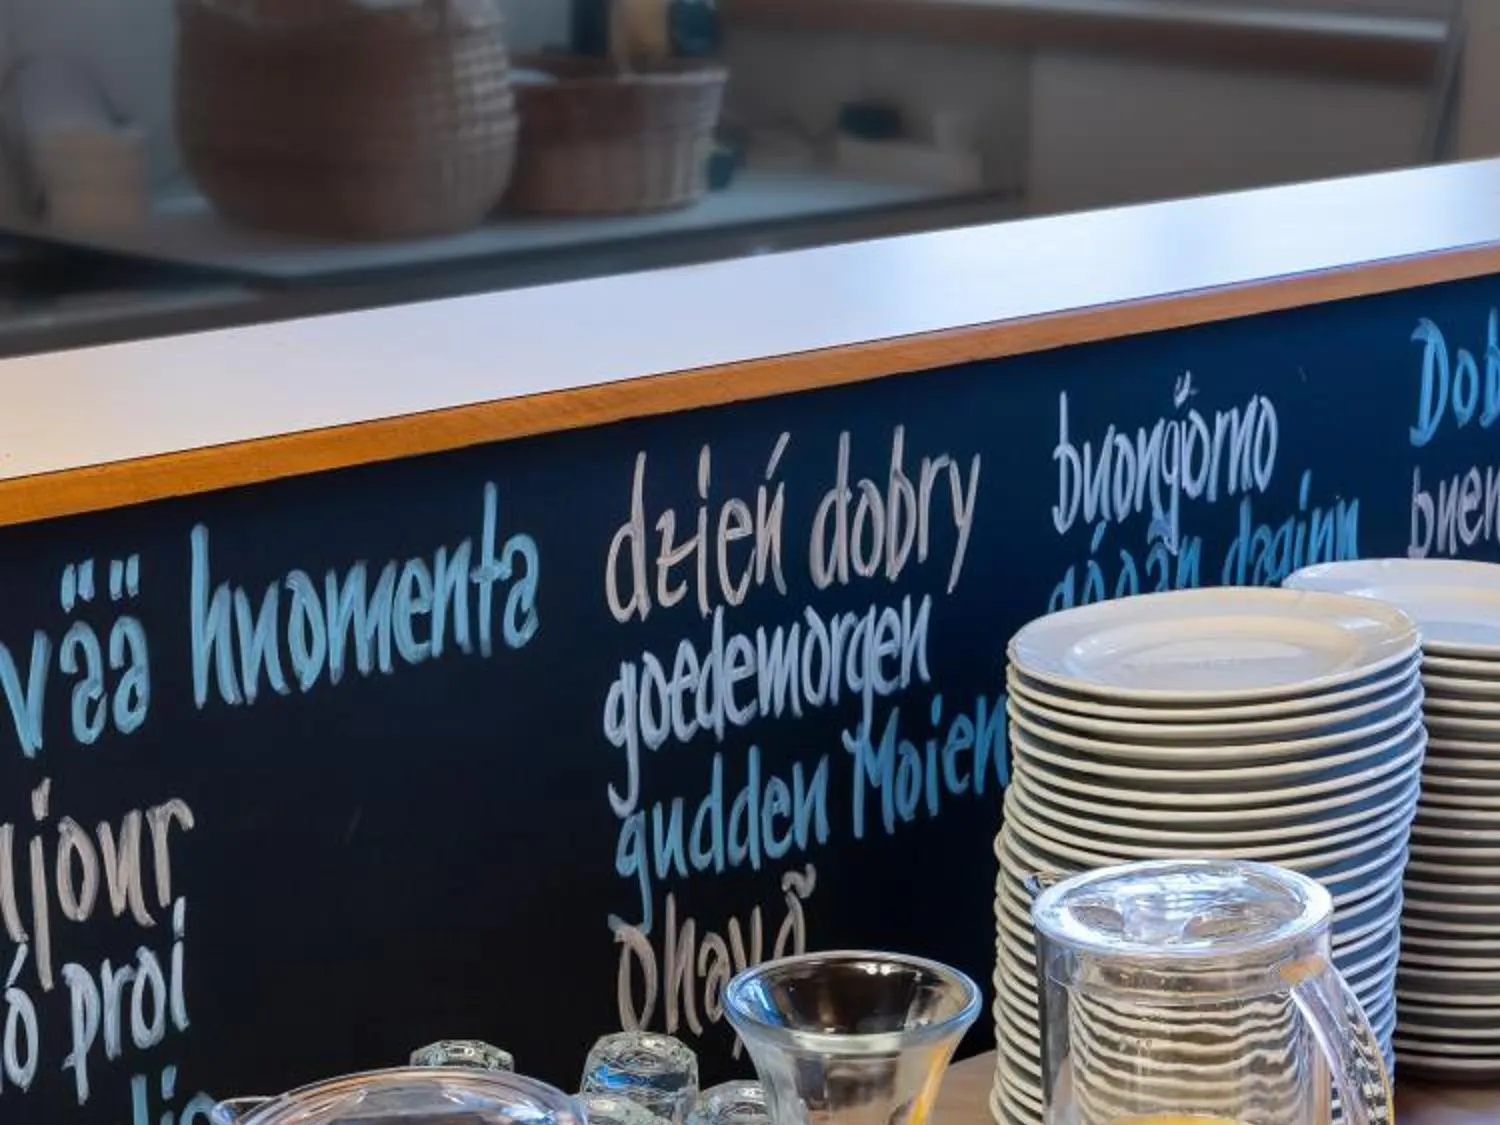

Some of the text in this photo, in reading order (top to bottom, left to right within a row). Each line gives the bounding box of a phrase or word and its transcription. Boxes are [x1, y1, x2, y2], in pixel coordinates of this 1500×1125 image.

[190, 480, 541, 708] huomenta
[808, 425, 982, 594] dobry
[603, 594, 932, 818] goedemorgen
[607, 692, 1009, 935] gudden Moien
[61, 895, 191, 1106] proi
